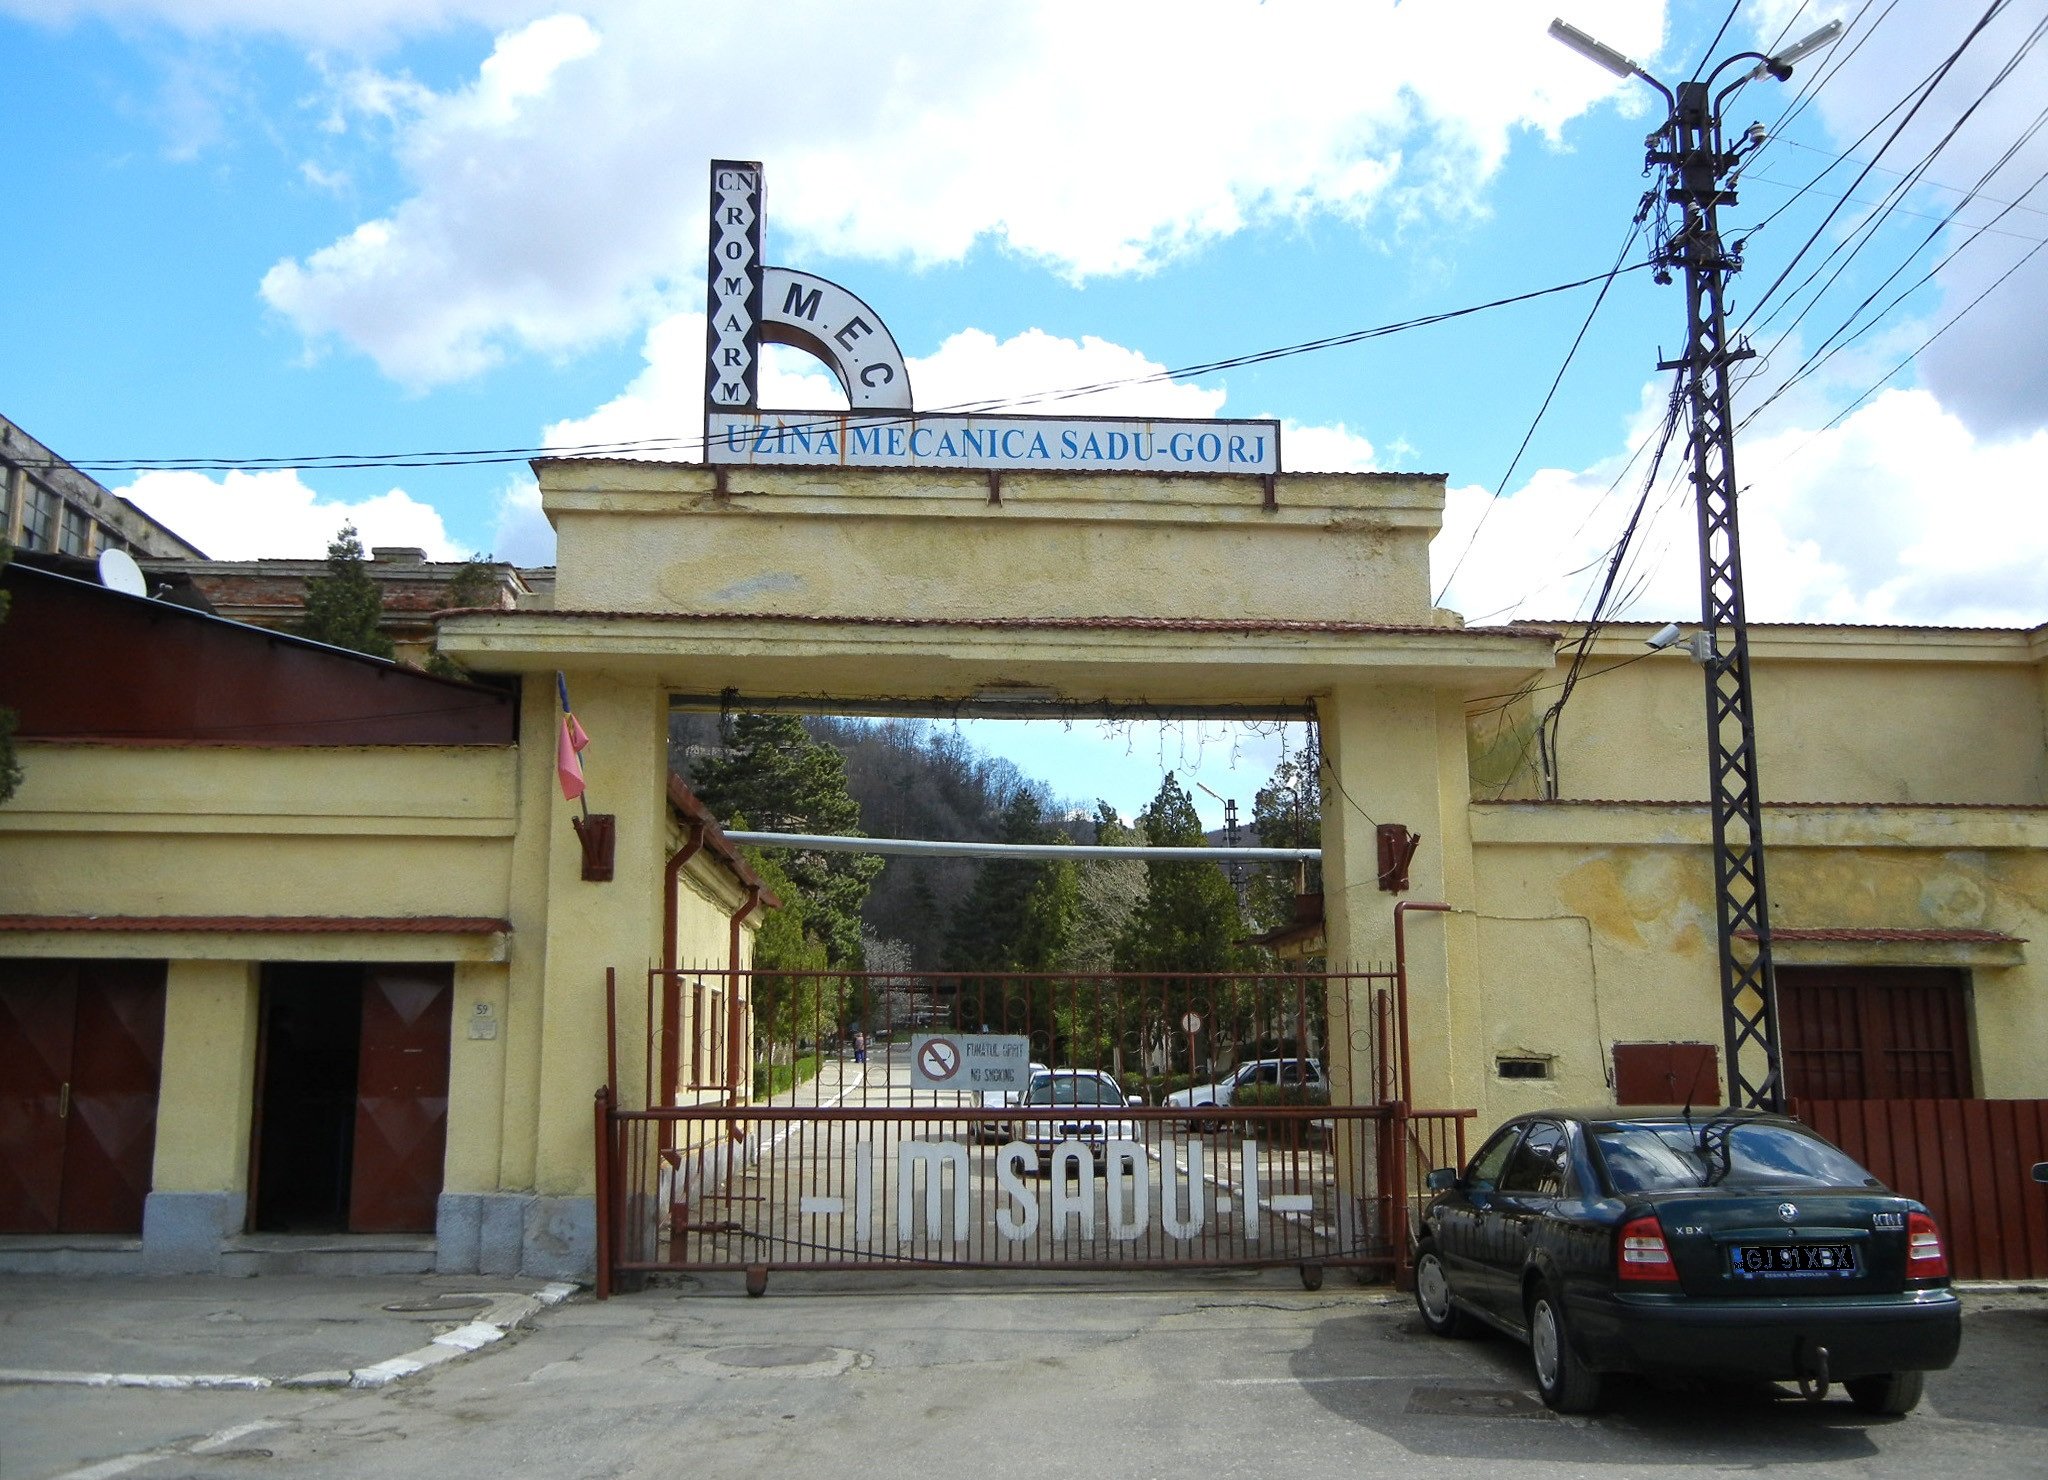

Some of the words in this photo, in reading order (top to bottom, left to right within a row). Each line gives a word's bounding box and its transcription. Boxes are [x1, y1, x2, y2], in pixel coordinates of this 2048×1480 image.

[723, 207, 745, 401] ROMARM
[727, 424, 839, 455] UZINA
[852, 426, 1050, 459] MECANICA
[1060, 430, 1265, 464] SADU-GORJ
